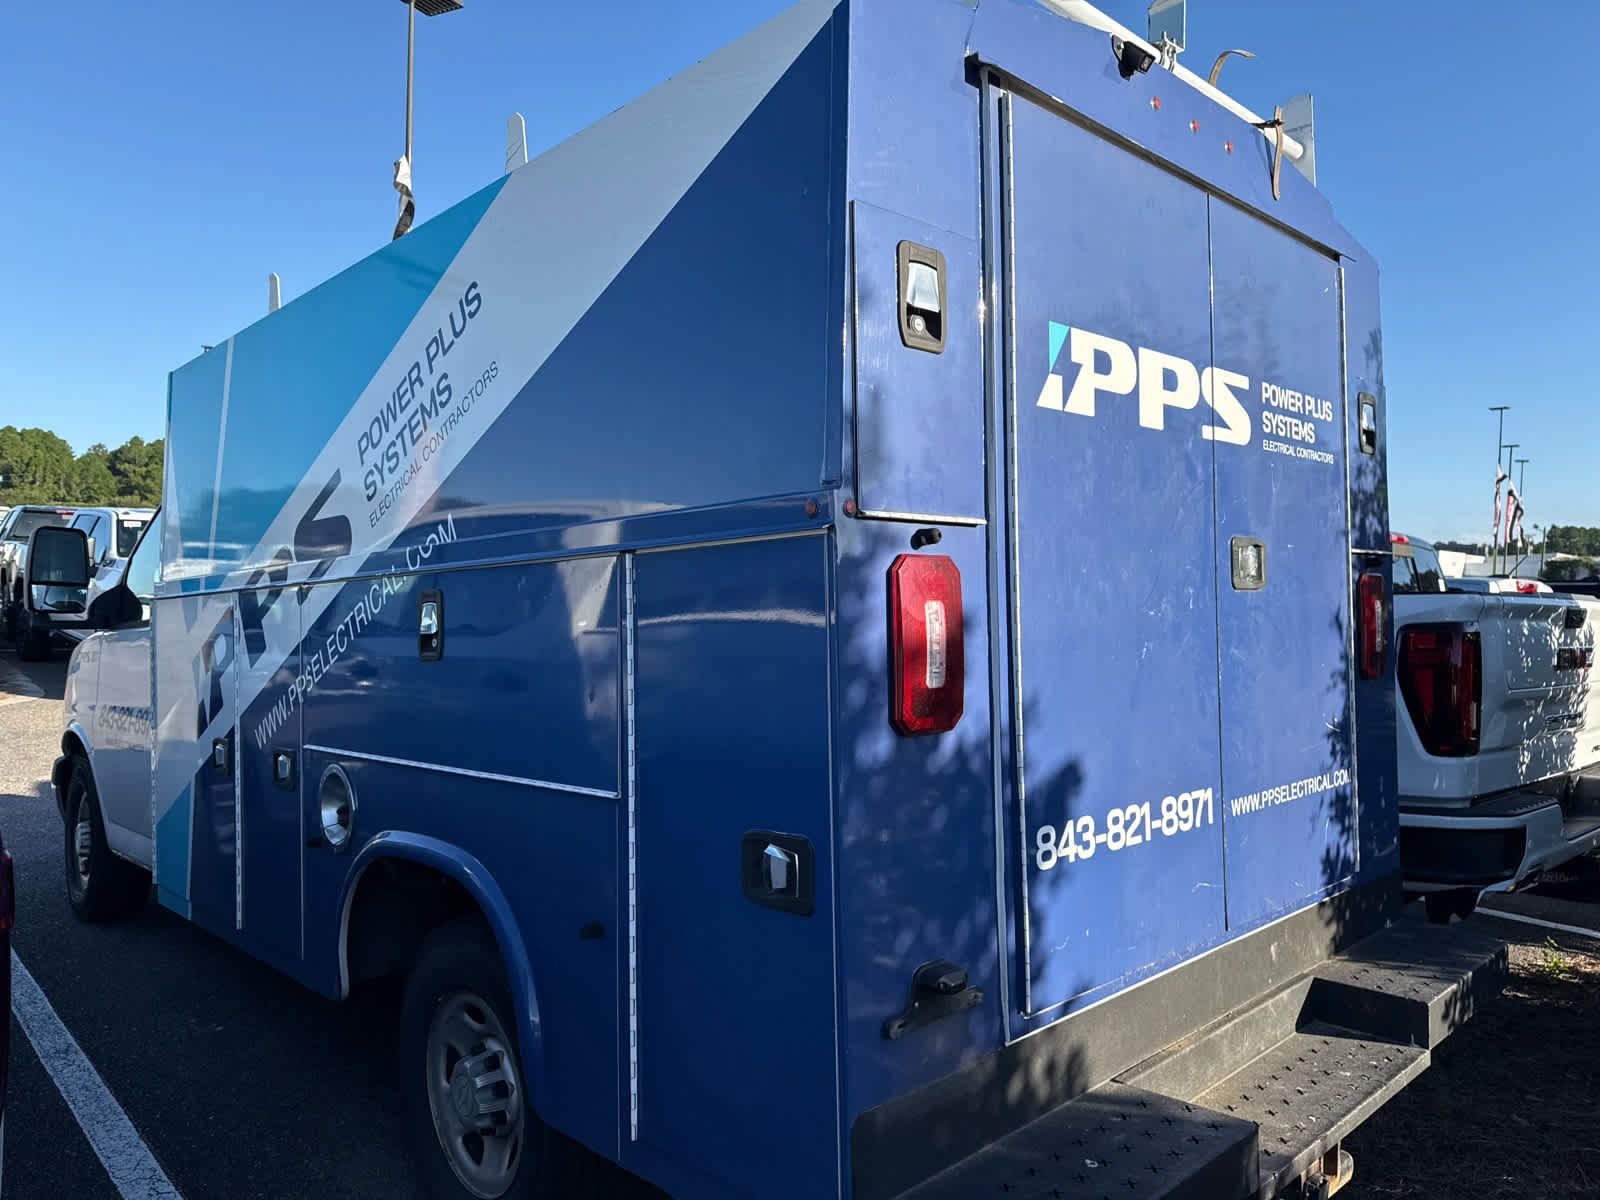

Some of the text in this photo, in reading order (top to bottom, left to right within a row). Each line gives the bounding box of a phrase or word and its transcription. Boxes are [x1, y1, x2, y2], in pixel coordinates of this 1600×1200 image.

[357, 281, 482, 466] POWER PLUS
[1036, 321, 1251, 446] PPS
[1262, 381, 1333, 422] POWER PLUS
[363, 372, 452, 502] SYSTEMS
[369, 360, 498, 528] ELECTRICAL CONTRACTORS
[1262, 411, 1315, 444] SYSTEMS
[1263, 440, 1334, 465] ELECTRICAL CONTRACTORS
[1036, 787, 1214, 870] 843-821-8971
